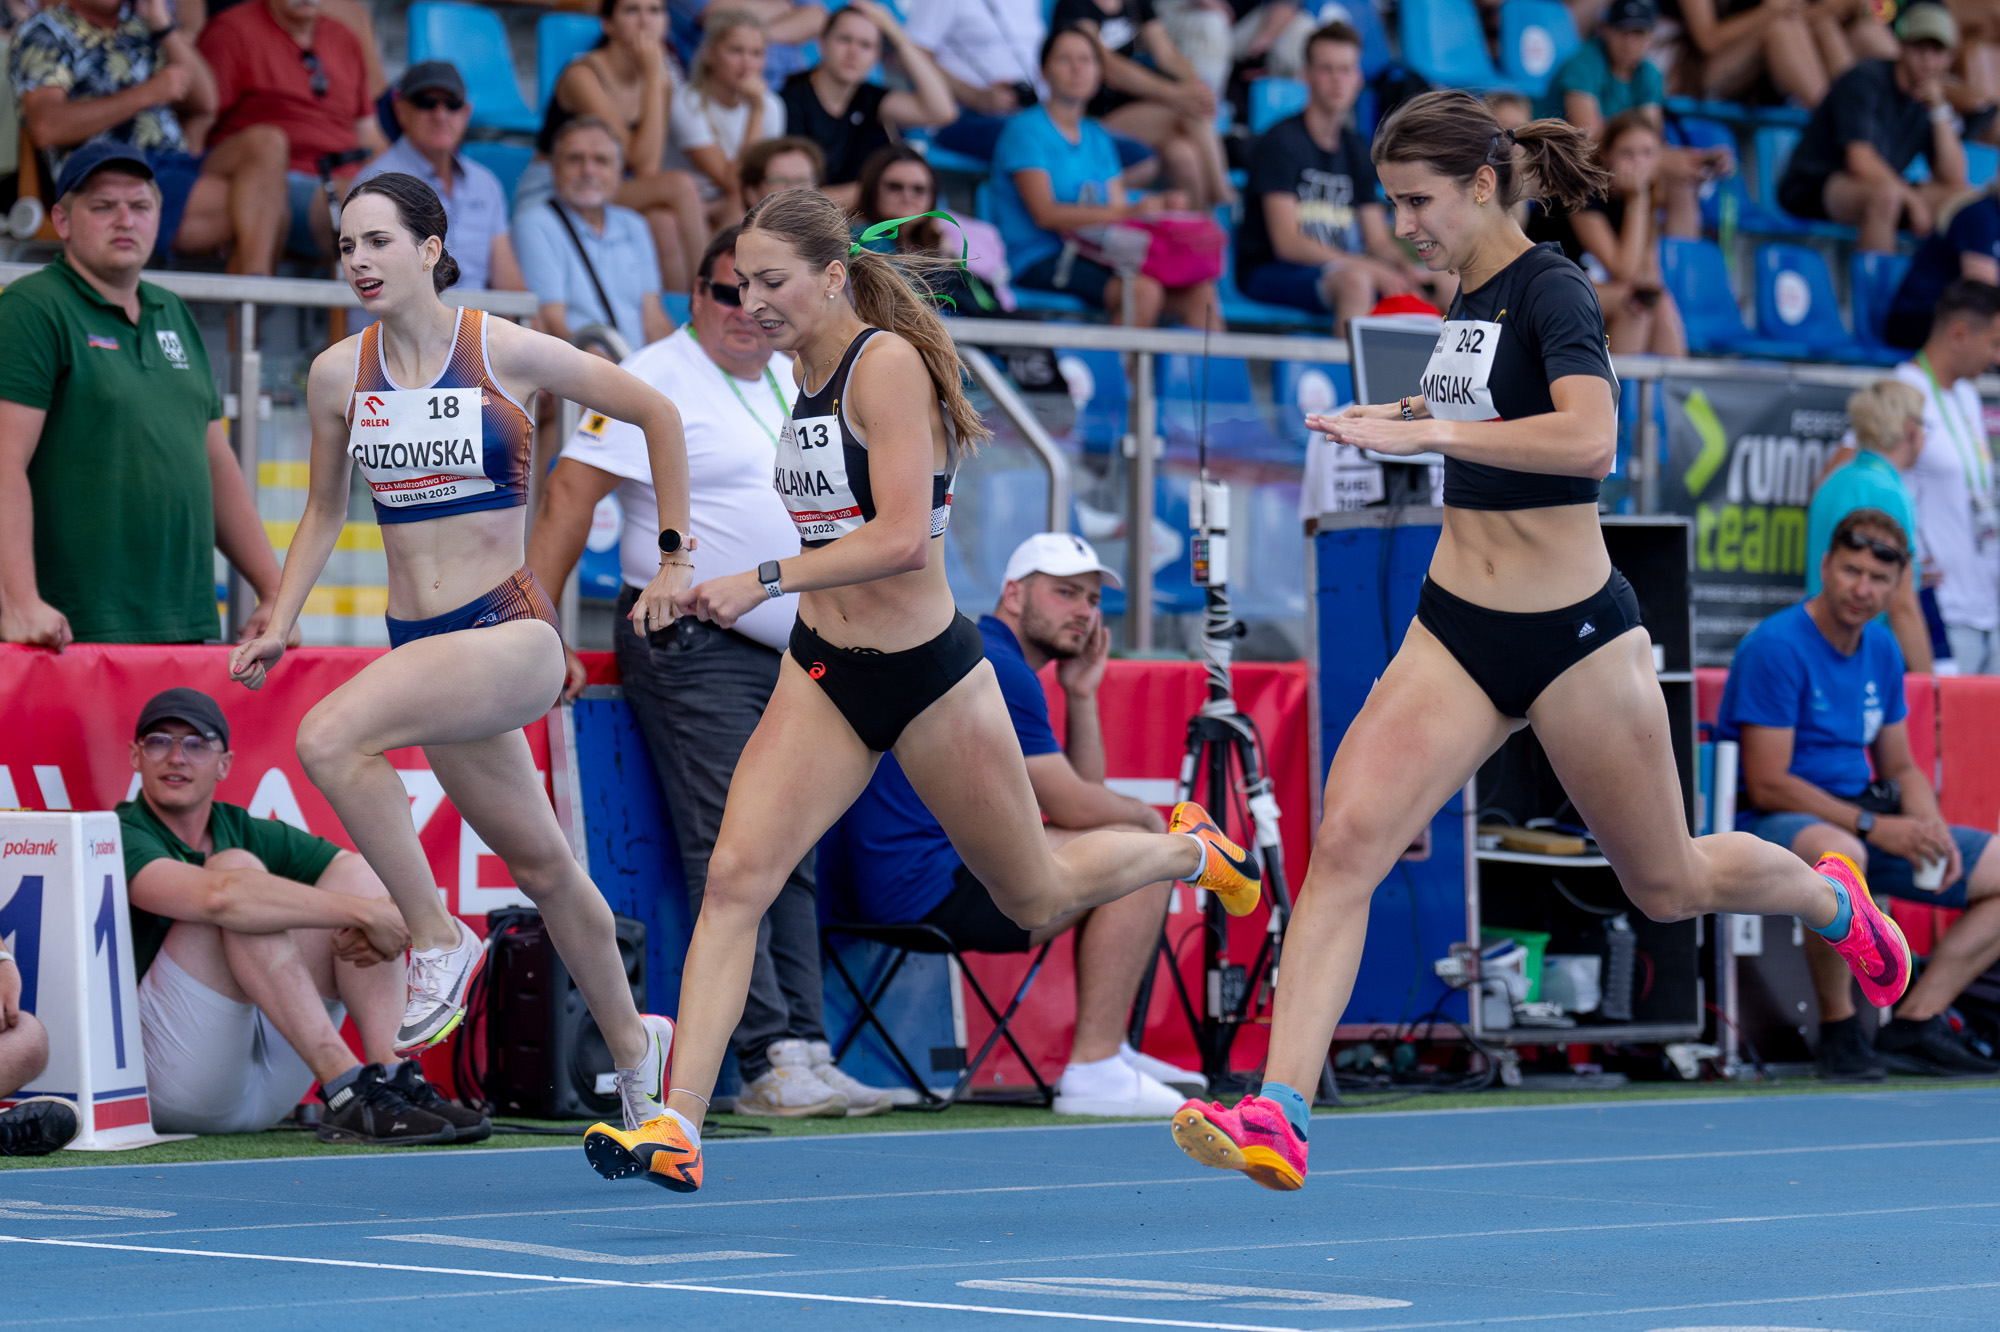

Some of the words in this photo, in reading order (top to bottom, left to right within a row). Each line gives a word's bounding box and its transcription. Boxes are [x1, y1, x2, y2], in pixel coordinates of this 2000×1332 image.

[1455, 328, 1485, 354] 242
[1422, 374, 1476, 405] MISIAK
[427, 395, 460, 420] 18
[360, 418, 390, 427] ORLEN
[792, 423, 829, 451] 13
[352, 438, 477, 470] GUZOWSKA
[775, 466, 836, 497] KLAMA
[1727, 434, 1840, 505] runn
[374, 483, 393, 491] PZLA
[394, 478, 440, 489] Mistrzostwa
[390, 492, 427, 503] LUBLIN
[428, 485, 458, 499] 2023
[836, 509, 852, 518] U20
[812, 523, 835, 534] 2023
[1696, 502, 1807, 576] team
[3, 838, 58, 857] polanik
[95, 838, 117, 858] polanik
[94, 874, 127, 1069] 1
